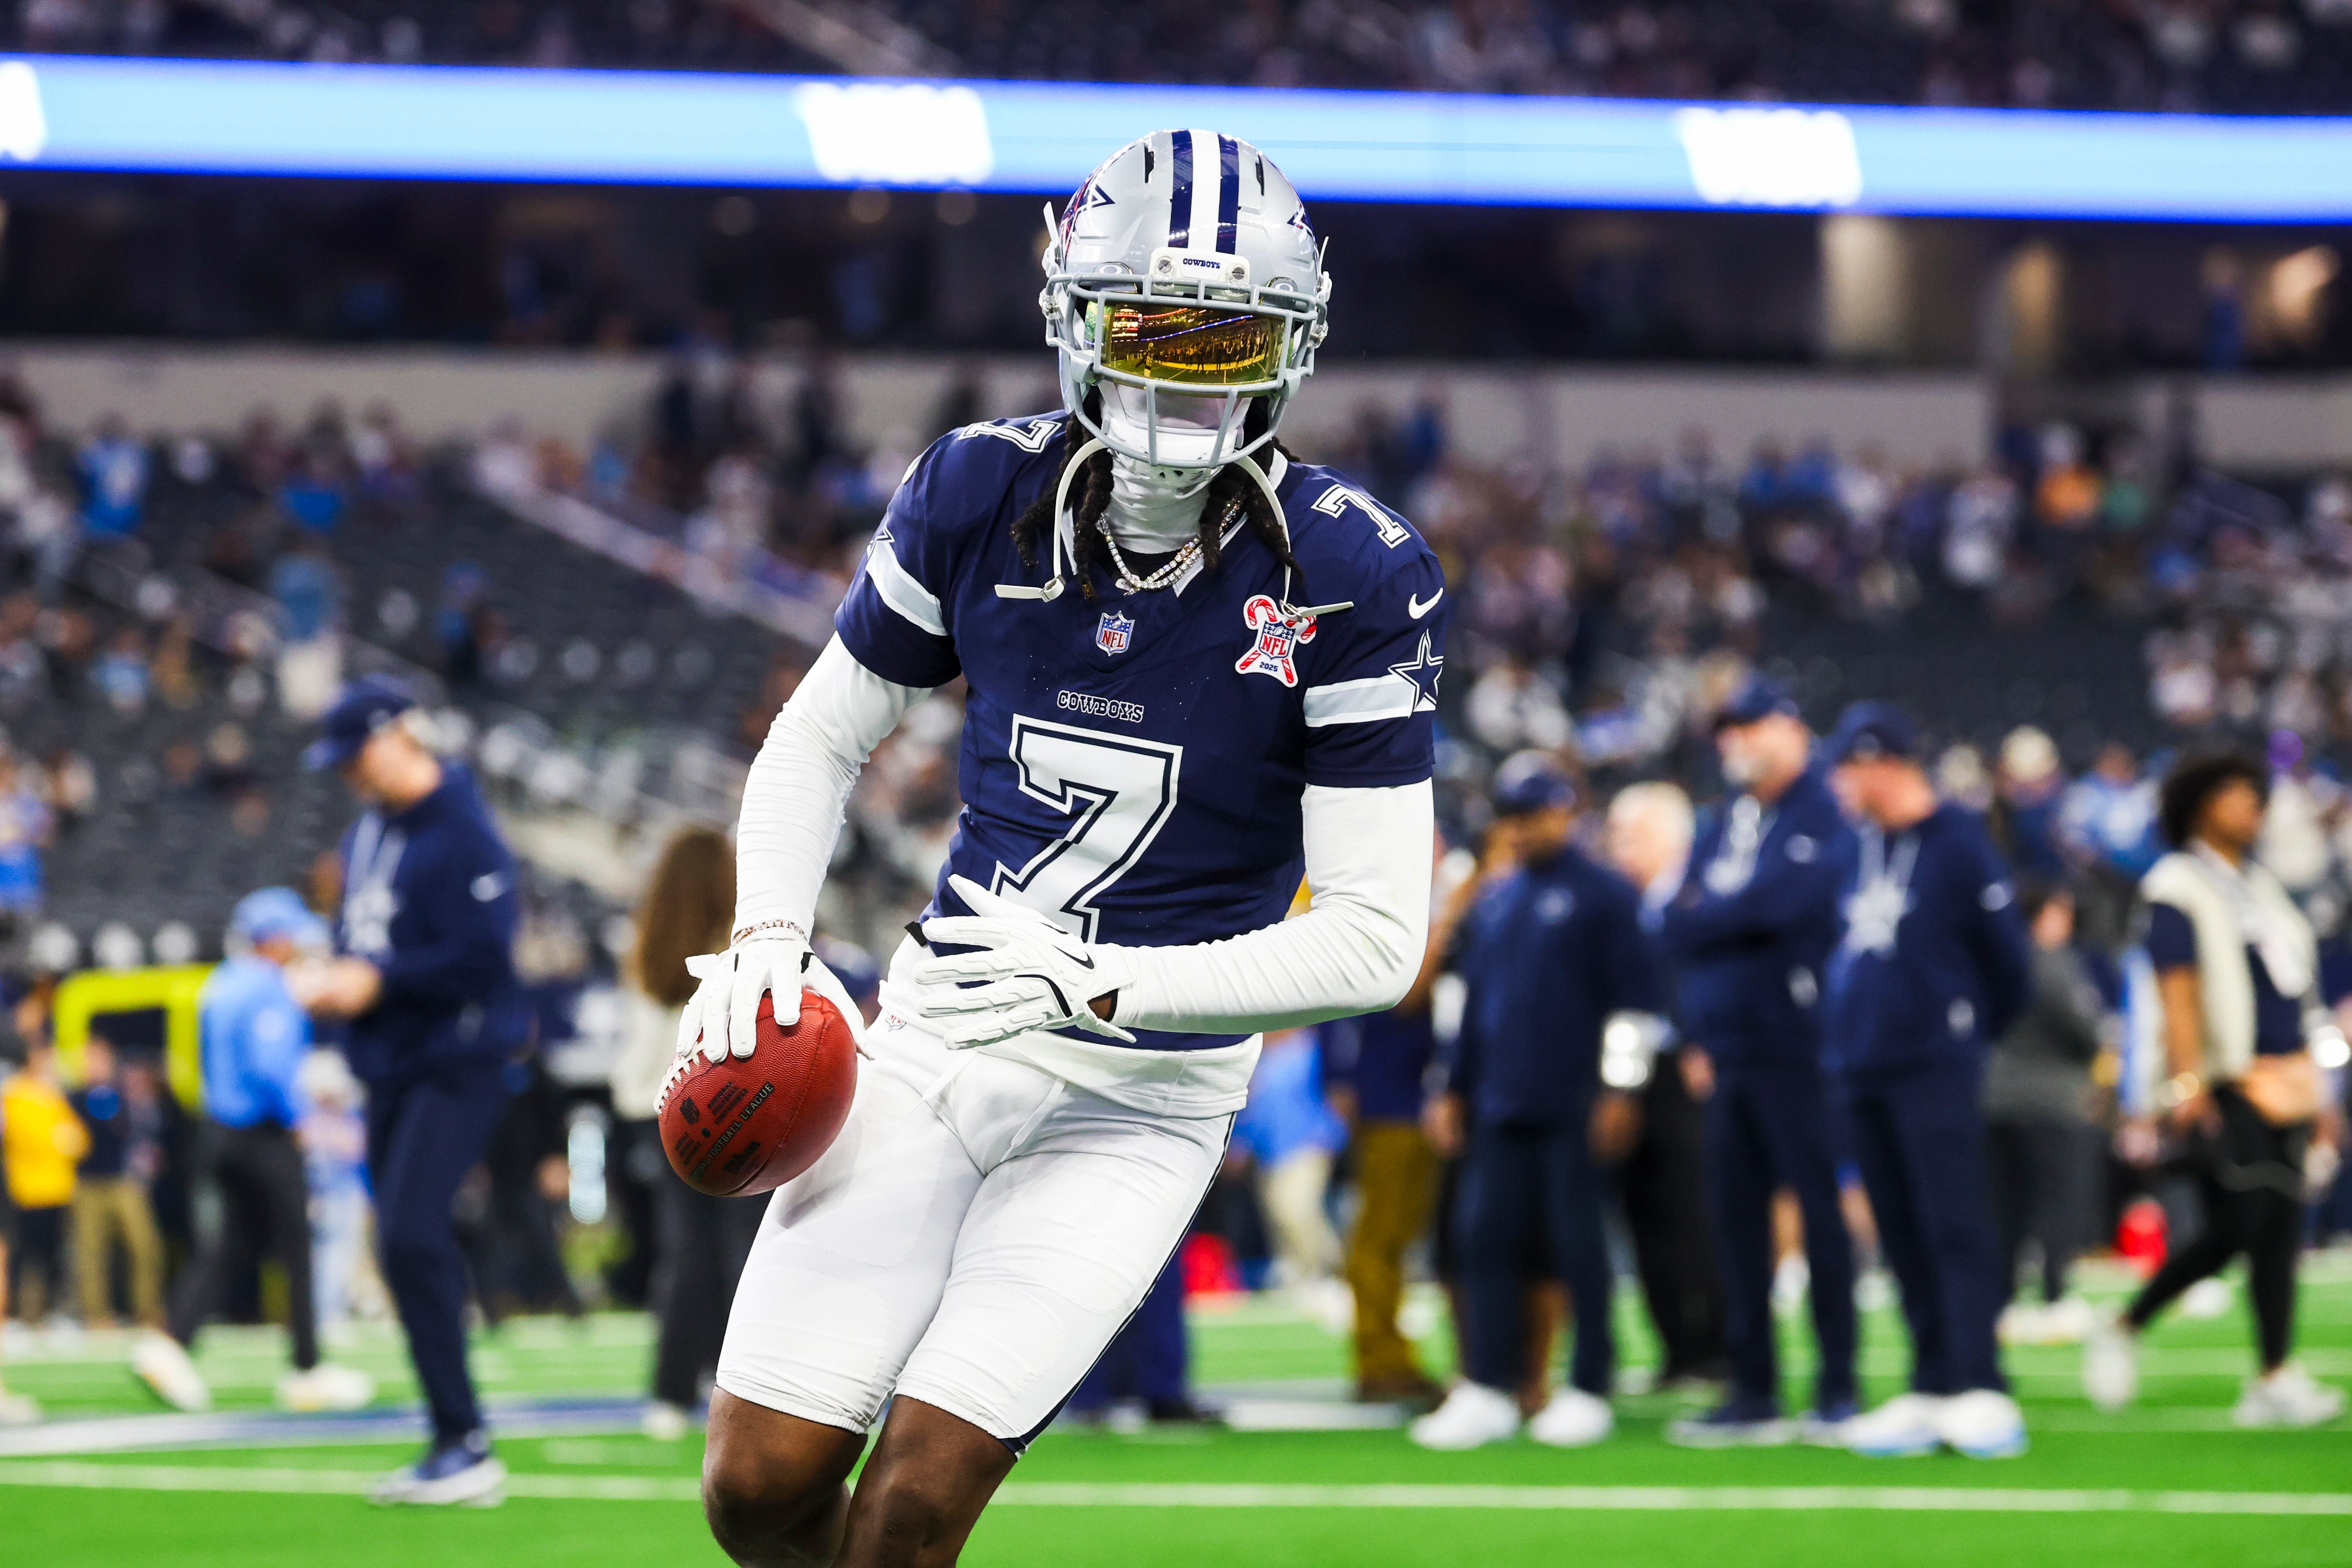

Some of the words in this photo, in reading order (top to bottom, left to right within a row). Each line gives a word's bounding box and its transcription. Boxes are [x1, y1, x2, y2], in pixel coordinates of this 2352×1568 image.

[1183, 258, 1220, 269] COWBOYS
[958, 419, 1062, 453] 7
[1311, 483, 1411, 549] 7
[1101, 630, 1124, 648] NFL
[1261, 635, 1287, 656] NFL
[1259, 662, 1278, 672] 2025
[1057, 690, 1145, 723] COWBOYS
[990, 713, 1184, 944] 7
[707, 1120, 742, 1159] FOOTBALL
[740, 1083, 774, 1120] LEAGUE
